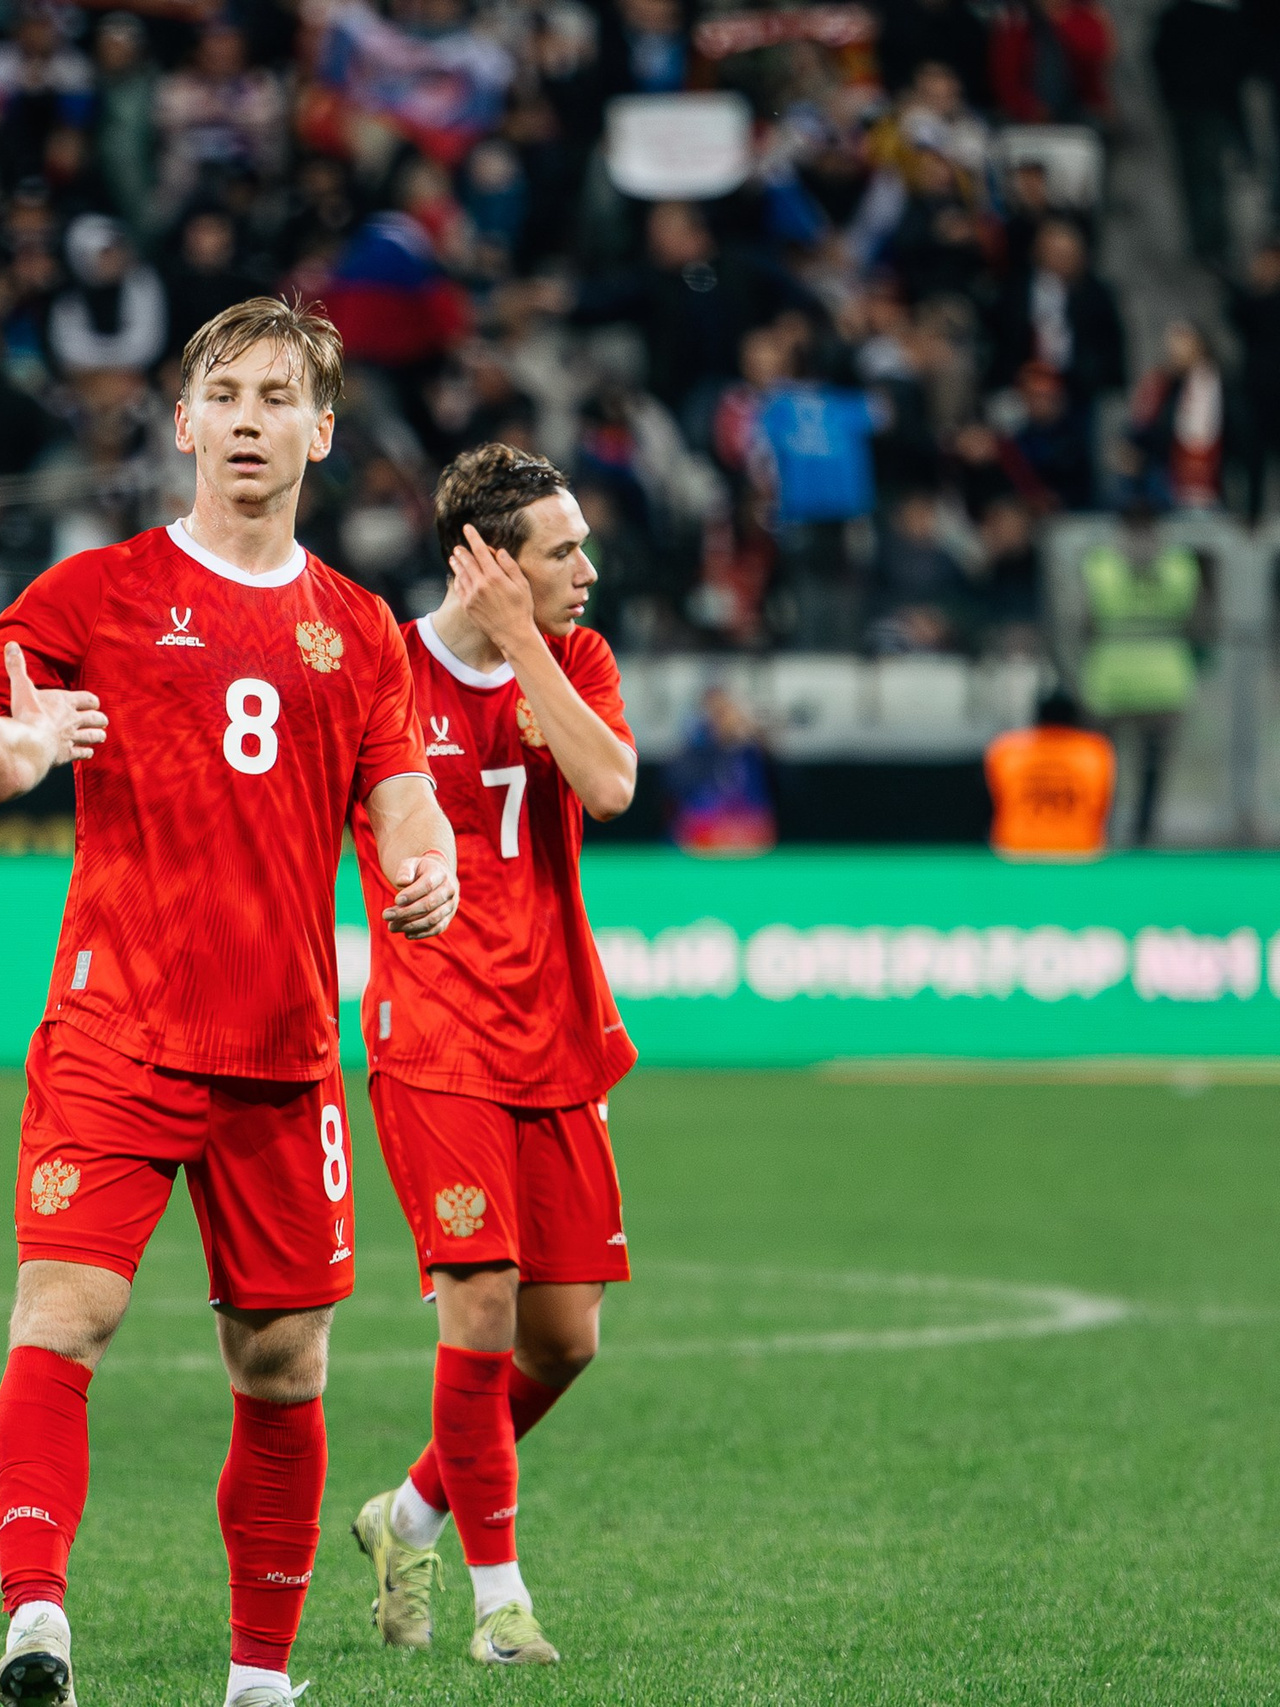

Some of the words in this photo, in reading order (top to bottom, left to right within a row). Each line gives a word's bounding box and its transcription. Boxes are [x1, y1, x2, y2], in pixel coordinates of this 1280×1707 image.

[155, 633, 206, 648] JÖGEL
[223, 677, 280, 775] 8
[480, 764, 527, 859] 7
[320, 1104, 348, 1202] 8
